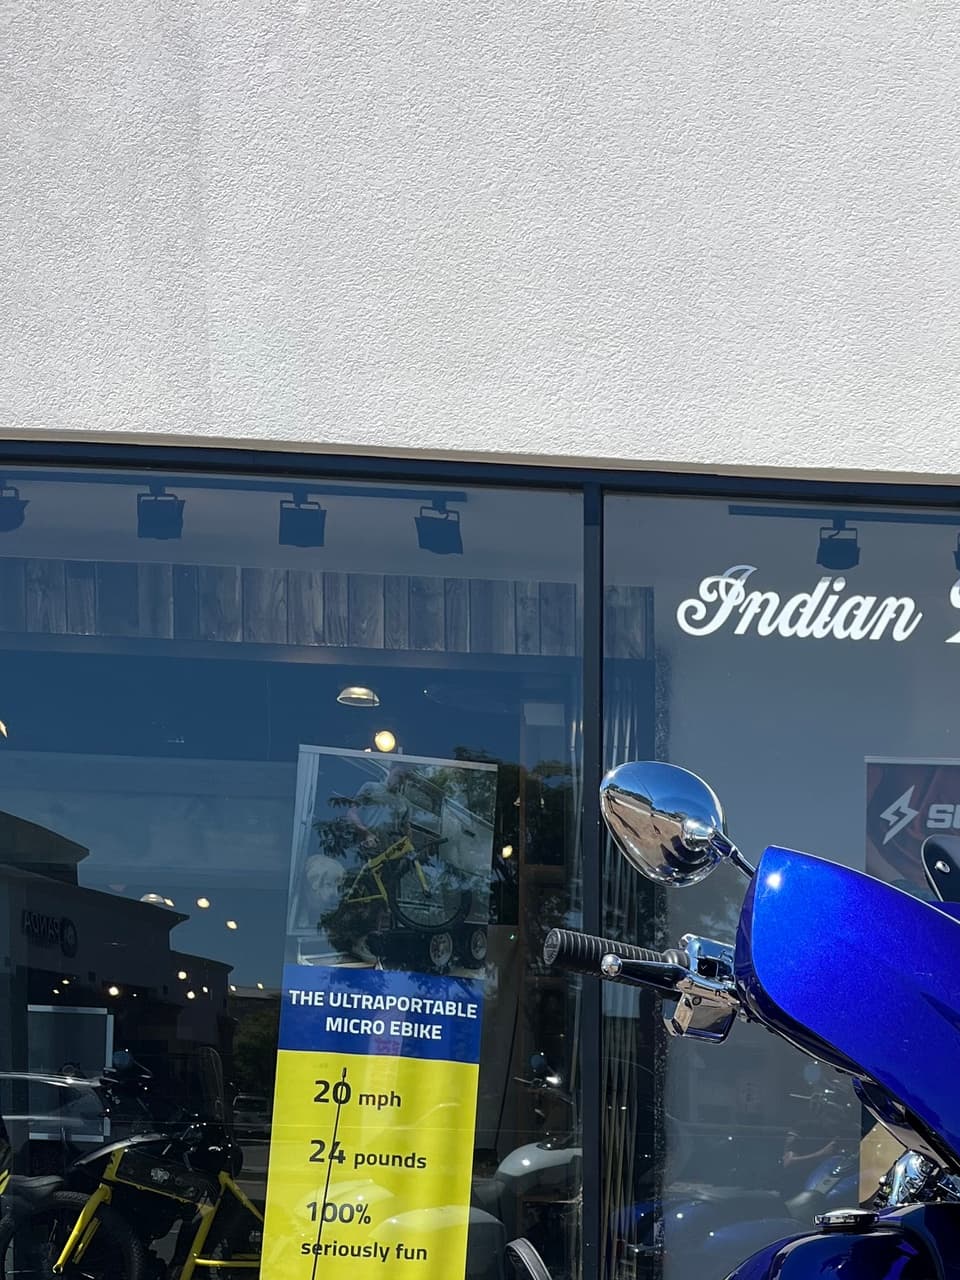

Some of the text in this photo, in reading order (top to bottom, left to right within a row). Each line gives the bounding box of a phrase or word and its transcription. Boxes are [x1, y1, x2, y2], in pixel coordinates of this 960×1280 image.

[677, 564, 922, 642] Indian
[289, 990, 478, 1019] THE ULTRAPORTABLE
[325, 1017, 443, 1040] MICRO EBIKE
[313, 1080, 402, 1111] 20 mph
[308, 1139, 427, 1169] 24 pounds
[306, 1201, 371, 1225] 100%
[301, 1240, 427, 1262] seriously fun
